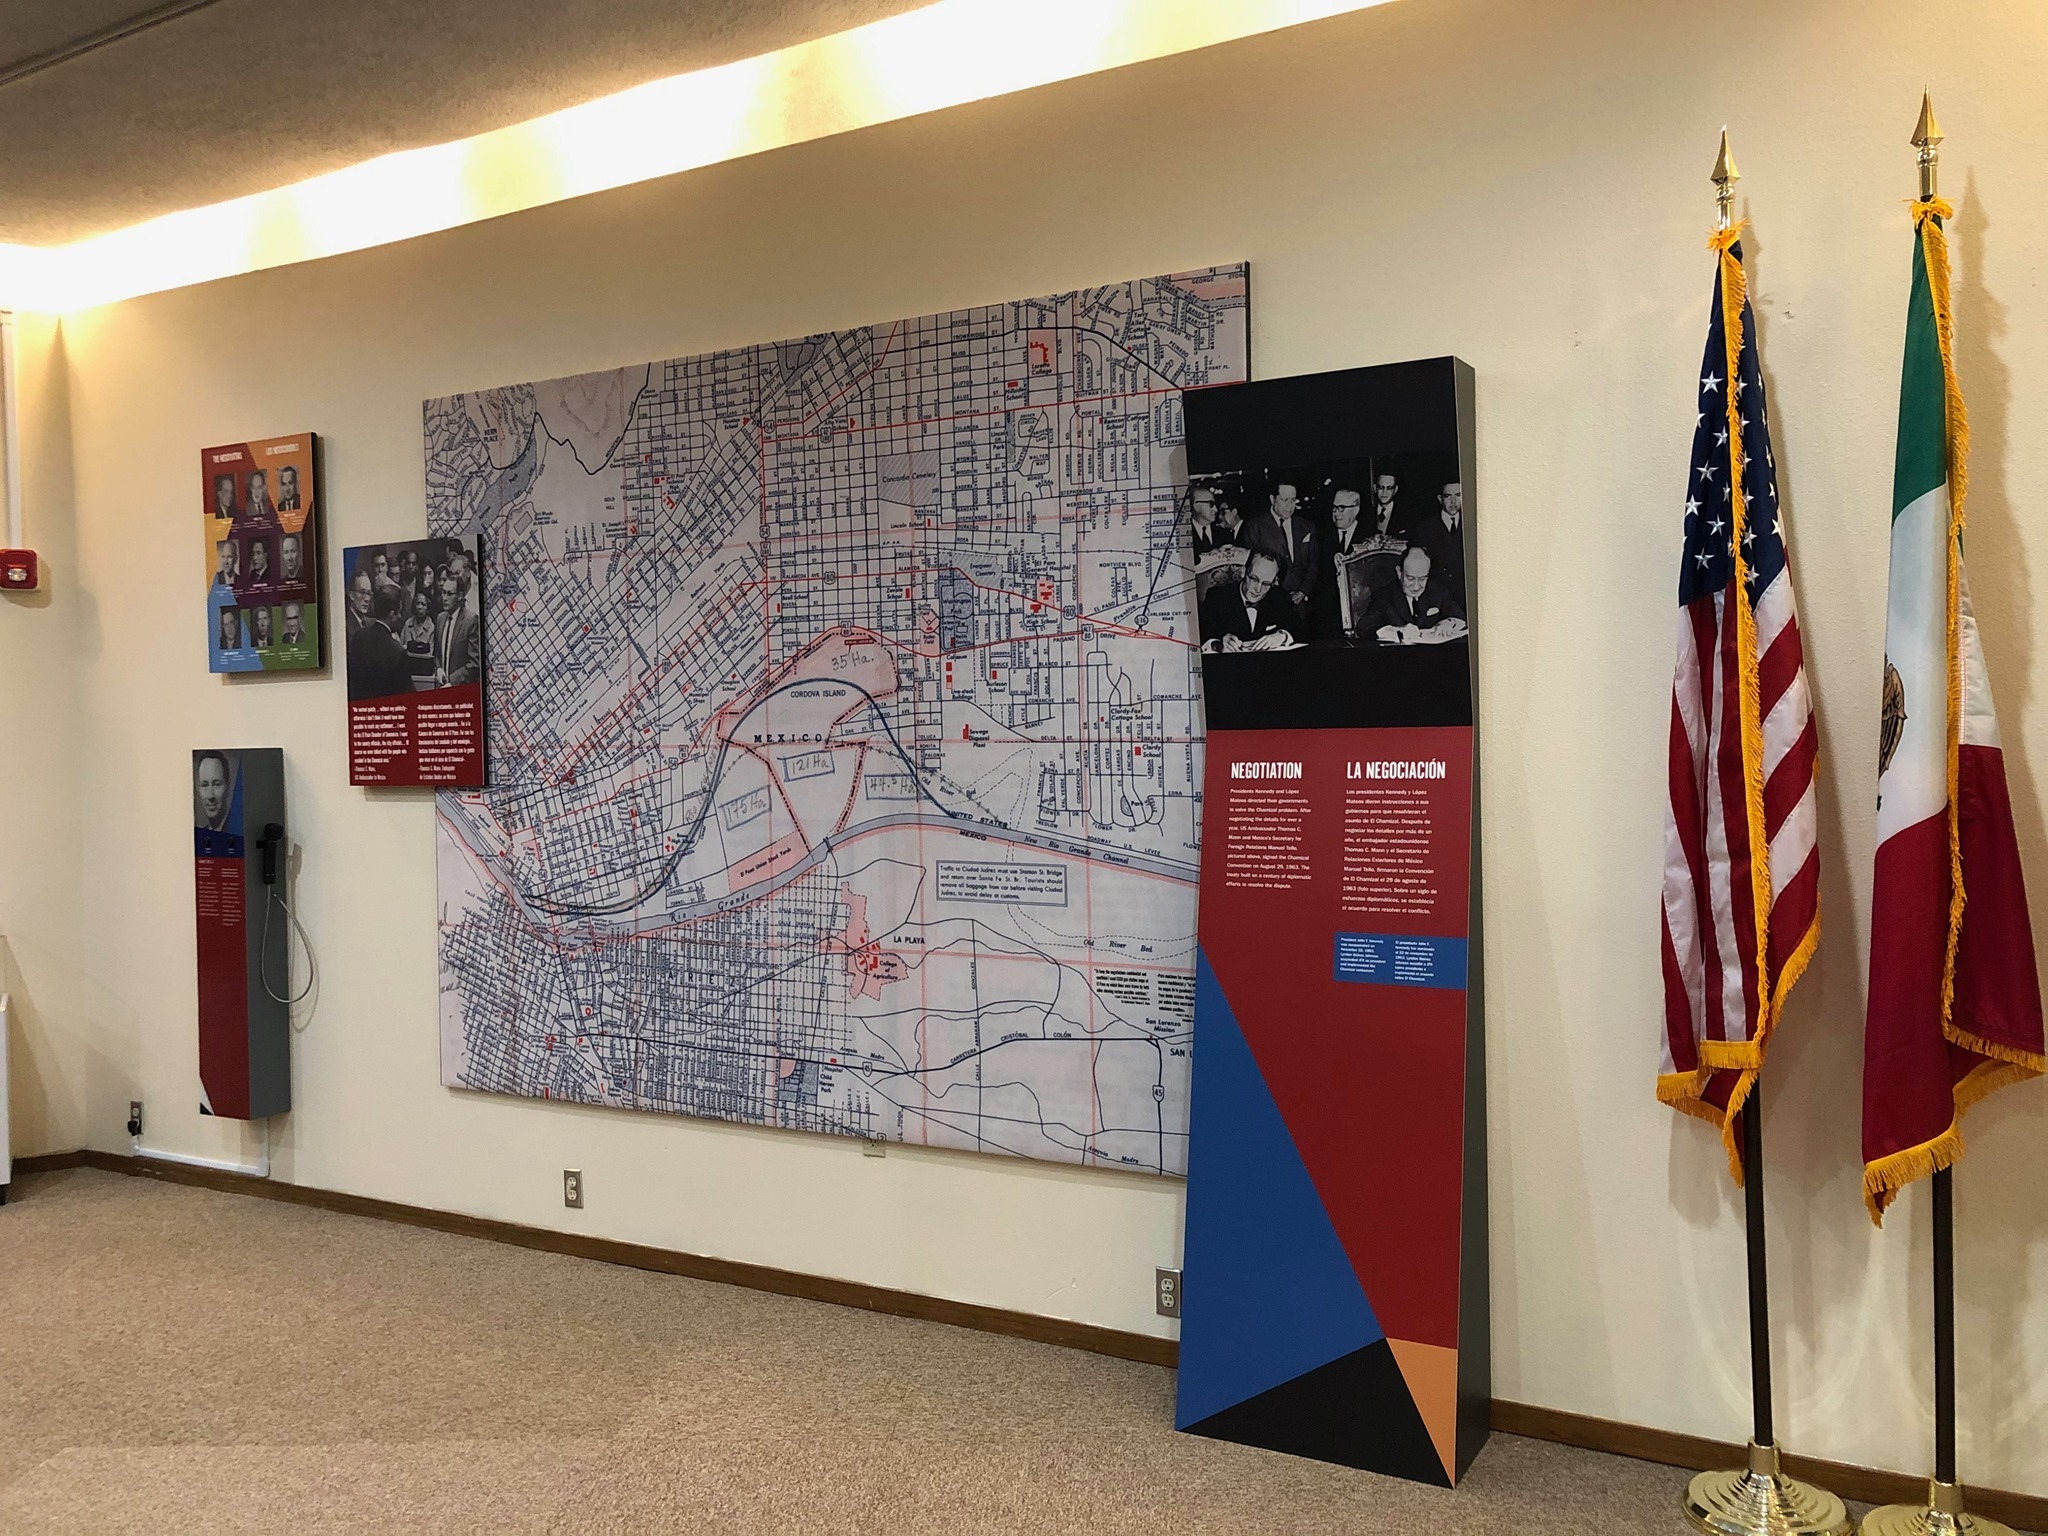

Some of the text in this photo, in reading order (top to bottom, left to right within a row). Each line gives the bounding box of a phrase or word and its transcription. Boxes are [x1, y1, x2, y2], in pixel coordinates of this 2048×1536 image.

[1153, 591, 1169, 600] Canal
[1101, 601, 1115, 610] PASO
[1065, 607, 1075, 617] 80
[754, 734, 822, 742] MEXICO
[1231, 762, 1302, 779] NEGOTIATION
[1347, 758, 1445, 779] LA NEGOCIACIÓN
[960, 830, 987, 841] MEXICO
[1024, 835, 1038, 845] New
[1069, 845, 1092, 857] Grande
[1103, 853, 1130, 865] Channel
[893, 935, 925, 945] LA PLAYA
[1109, 940, 1127, 949] River
[1159, 1019, 1181, 1027] Lorenzo
[1154, 1025, 1175, 1033] Mission
[1170, 1048, 1185, 1057] SAN
[1154, 1089, 1162, 1097] 45
